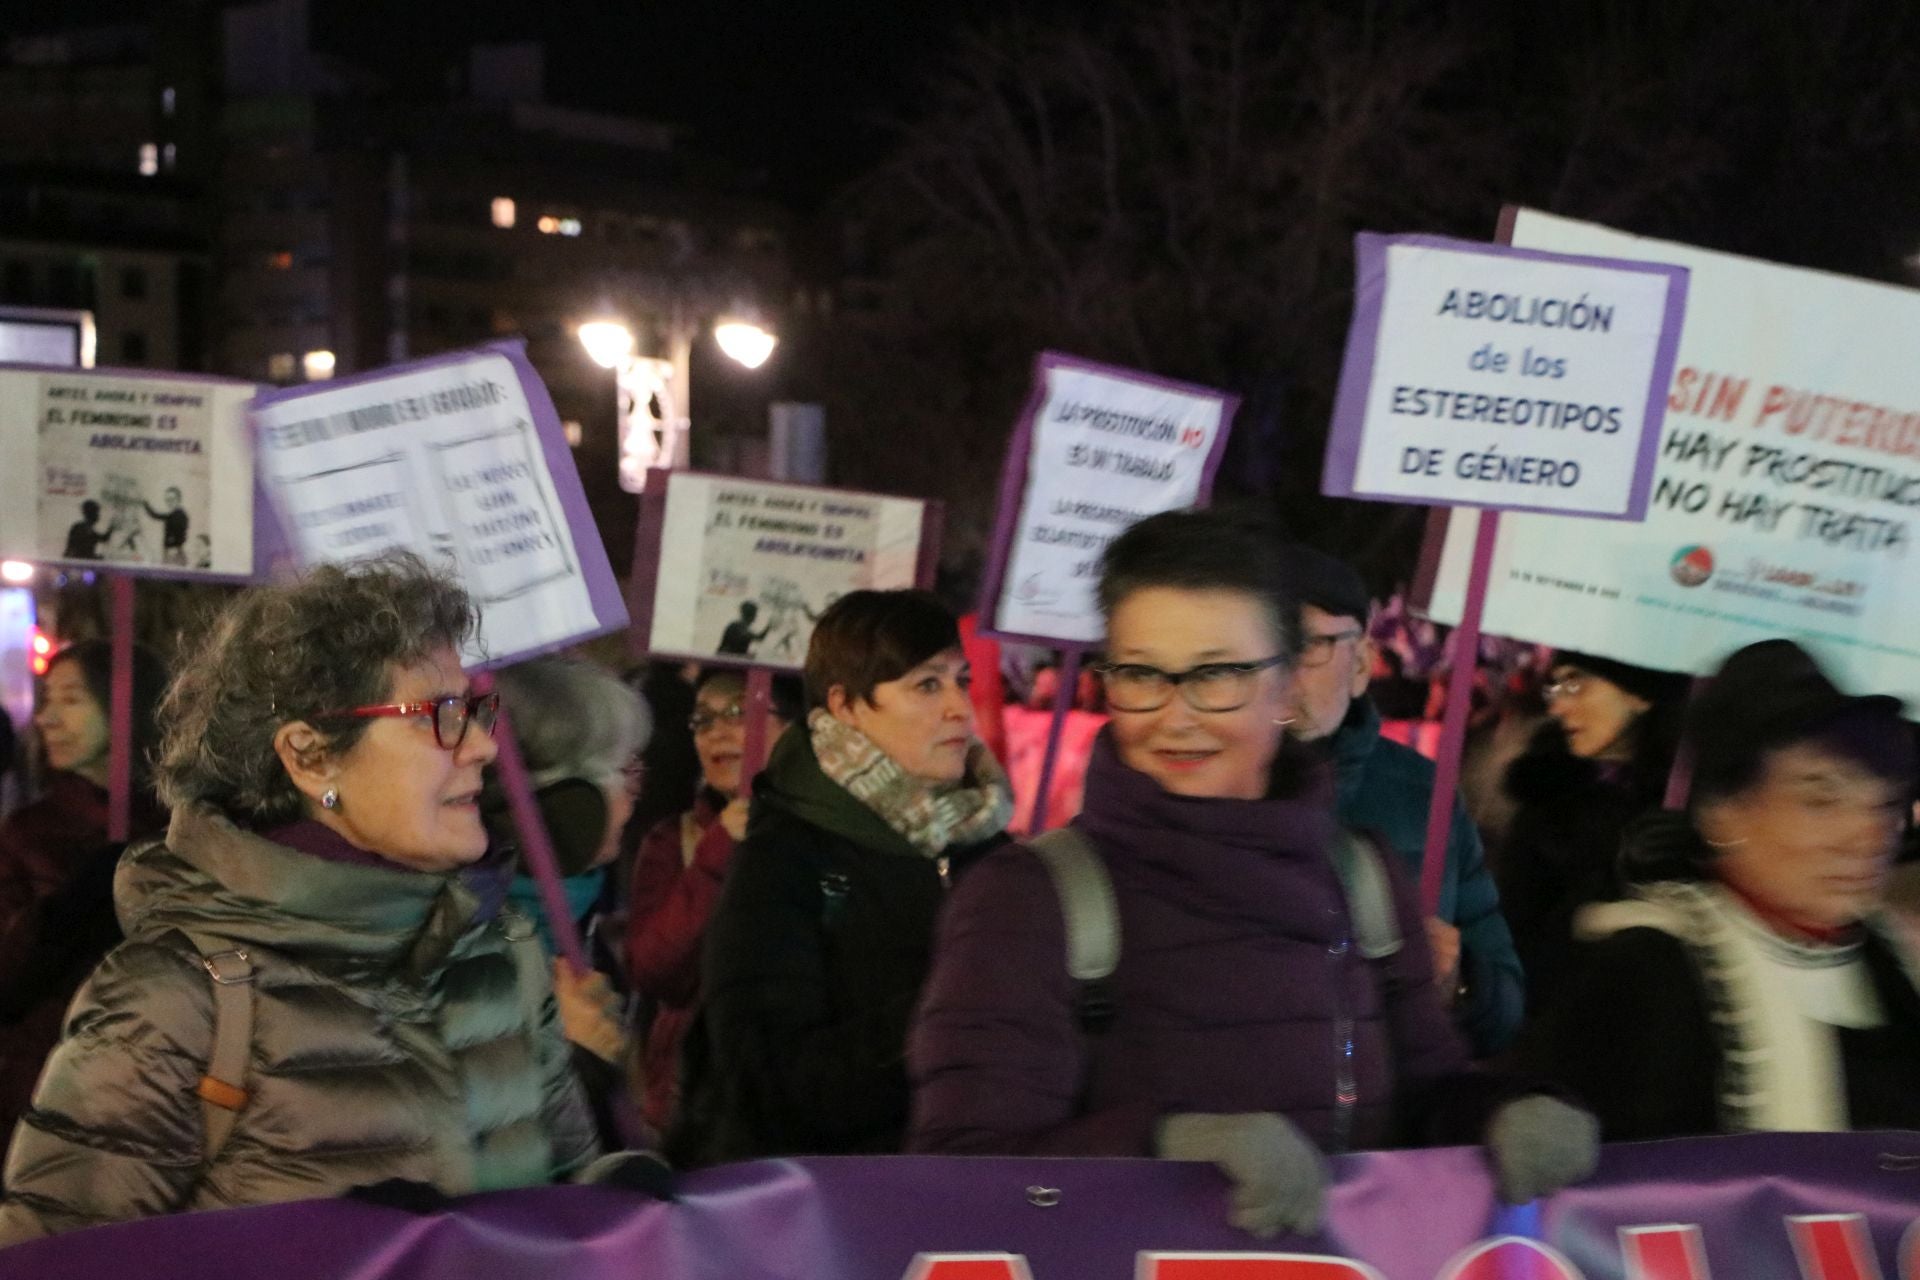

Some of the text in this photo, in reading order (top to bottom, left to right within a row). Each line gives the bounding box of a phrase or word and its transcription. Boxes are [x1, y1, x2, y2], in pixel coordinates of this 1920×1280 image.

[1436, 288, 1615, 334] ABOLICIÓN
[1468, 342, 1568, 379] de los
[47, 408, 65, 425] EL
[1391, 386, 1624, 435] ESTEREOTIPOS
[1668, 367, 1750, 422] SIN
[1400, 444, 1582, 488] DE GÉNERO
[1663, 428, 1741, 473] HAY
[1653, 475, 1711, 514] NO
[1716, 490, 1796, 533] HAY
